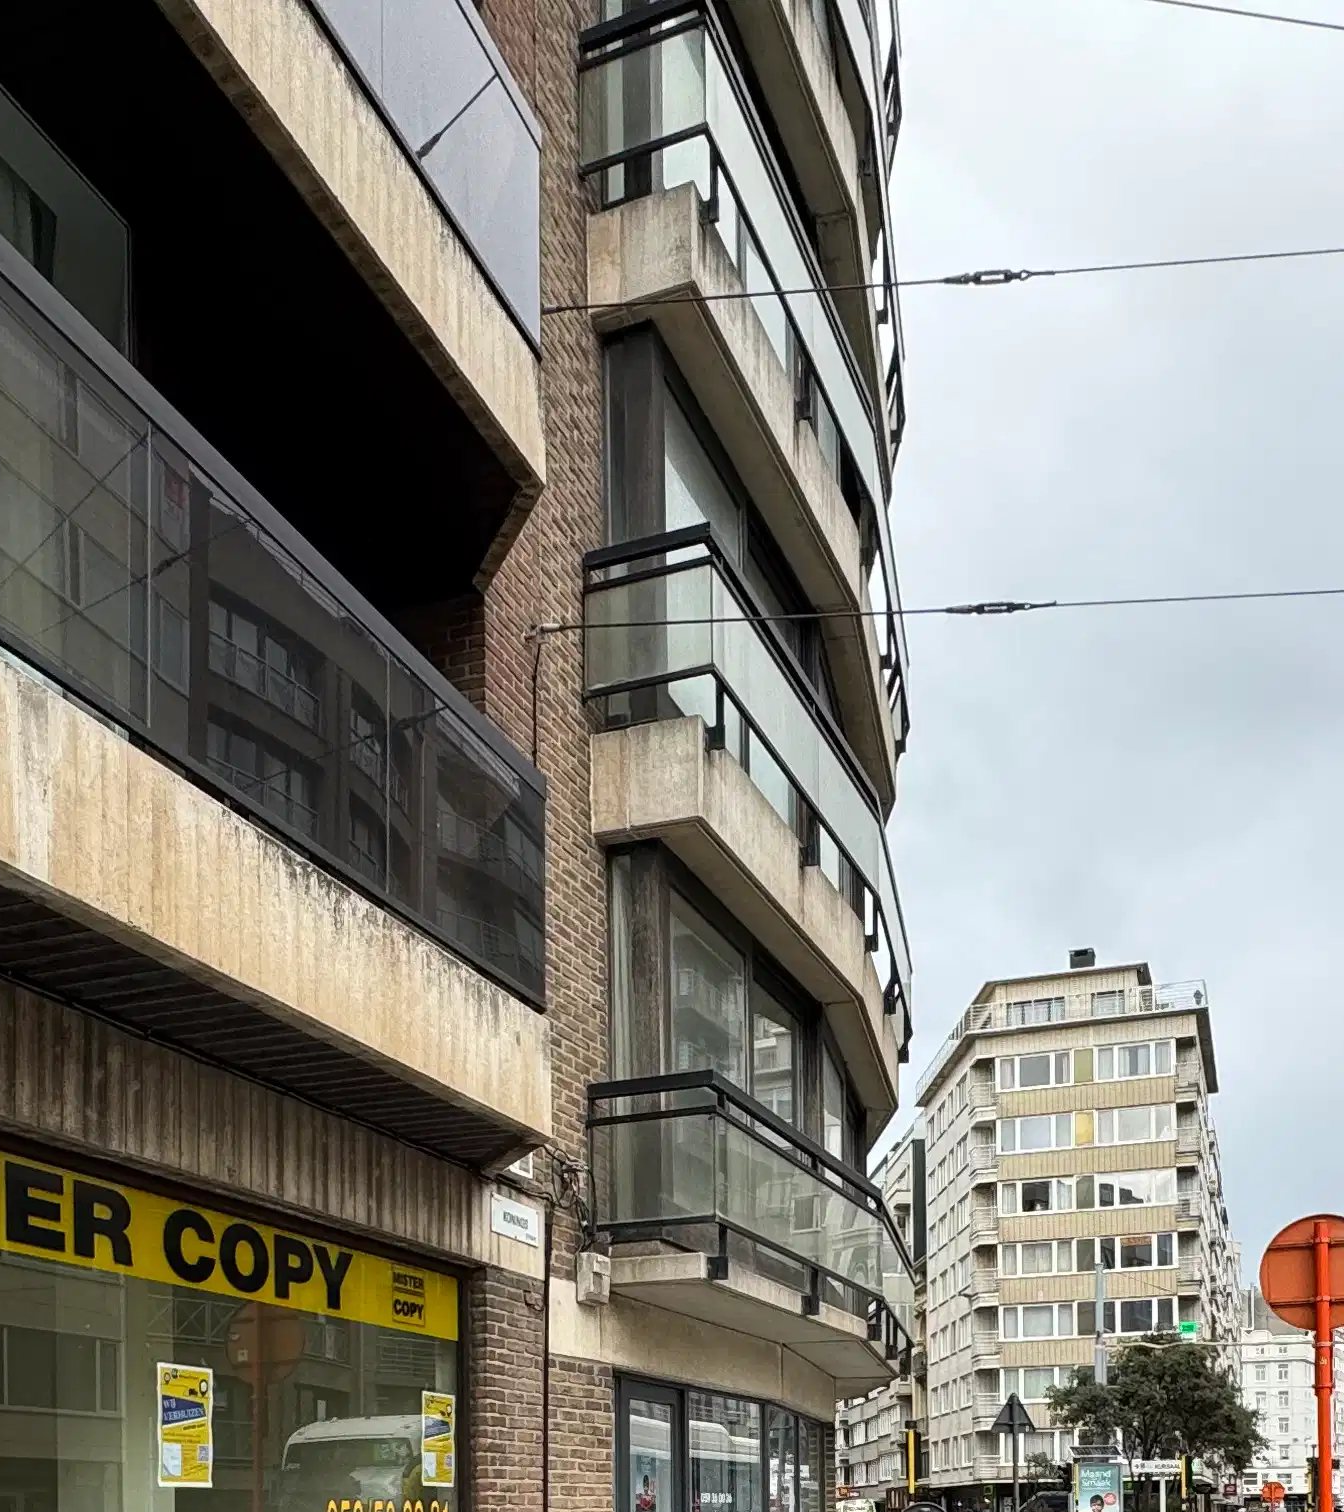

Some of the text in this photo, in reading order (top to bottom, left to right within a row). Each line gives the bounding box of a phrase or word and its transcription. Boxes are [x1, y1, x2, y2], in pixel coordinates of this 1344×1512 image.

[163, 1209, 353, 1309] COPY
[393, 1271, 425, 1289] MISTER
[393, 1298, 424, 1320] COPY
